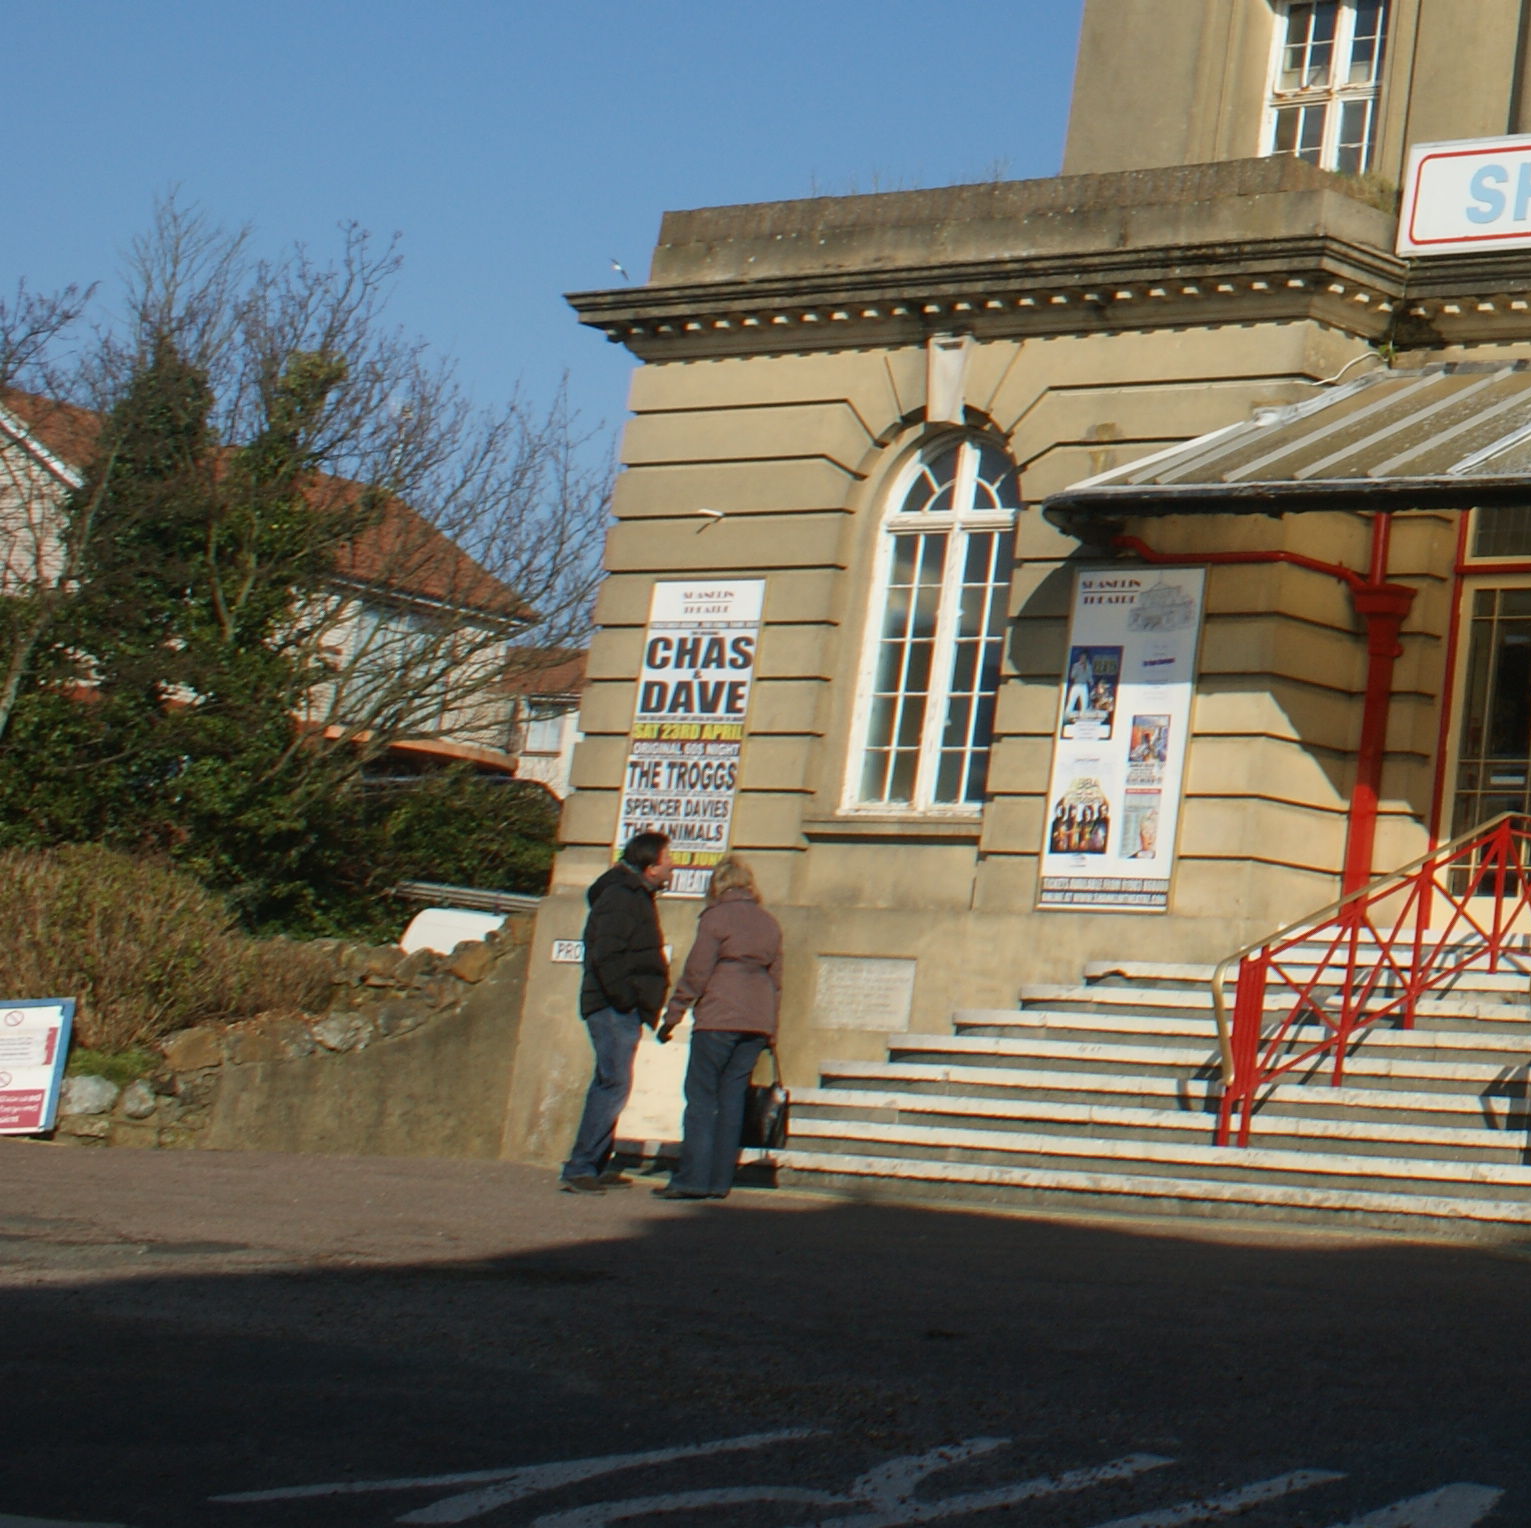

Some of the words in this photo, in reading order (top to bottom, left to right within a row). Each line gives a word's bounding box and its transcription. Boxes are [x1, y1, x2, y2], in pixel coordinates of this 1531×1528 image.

[1081, 579, 1142, 590] SHANKLIN
[1083, 595, 1137, 605] THEATRE
[645, 636, 755, 670] CHAS
[693, 670, 703, 679] &
[639, 680, 748, 714] DAVE
[634, 723, 659, 739] SAT
[661, 724, 701, 740] 23RD
[703, 725, 742, 740] APRIL
[633, 742, 682, 754] ORIGINAL
[706, 744, 740, 756] NIGHT
[629, 761, 663, 789] THE
[668, 762, 737, 791] TROGGS
[625, 798, 682, 817] SPENCER
[684, 799, 730, 818] DAVIES
[624, 823, 655, 839] THE
[657, 823, 724, 842] ANIMALS
[671, 868, 713, 892] THEAT
[557, 942, 584, 960] PRO
